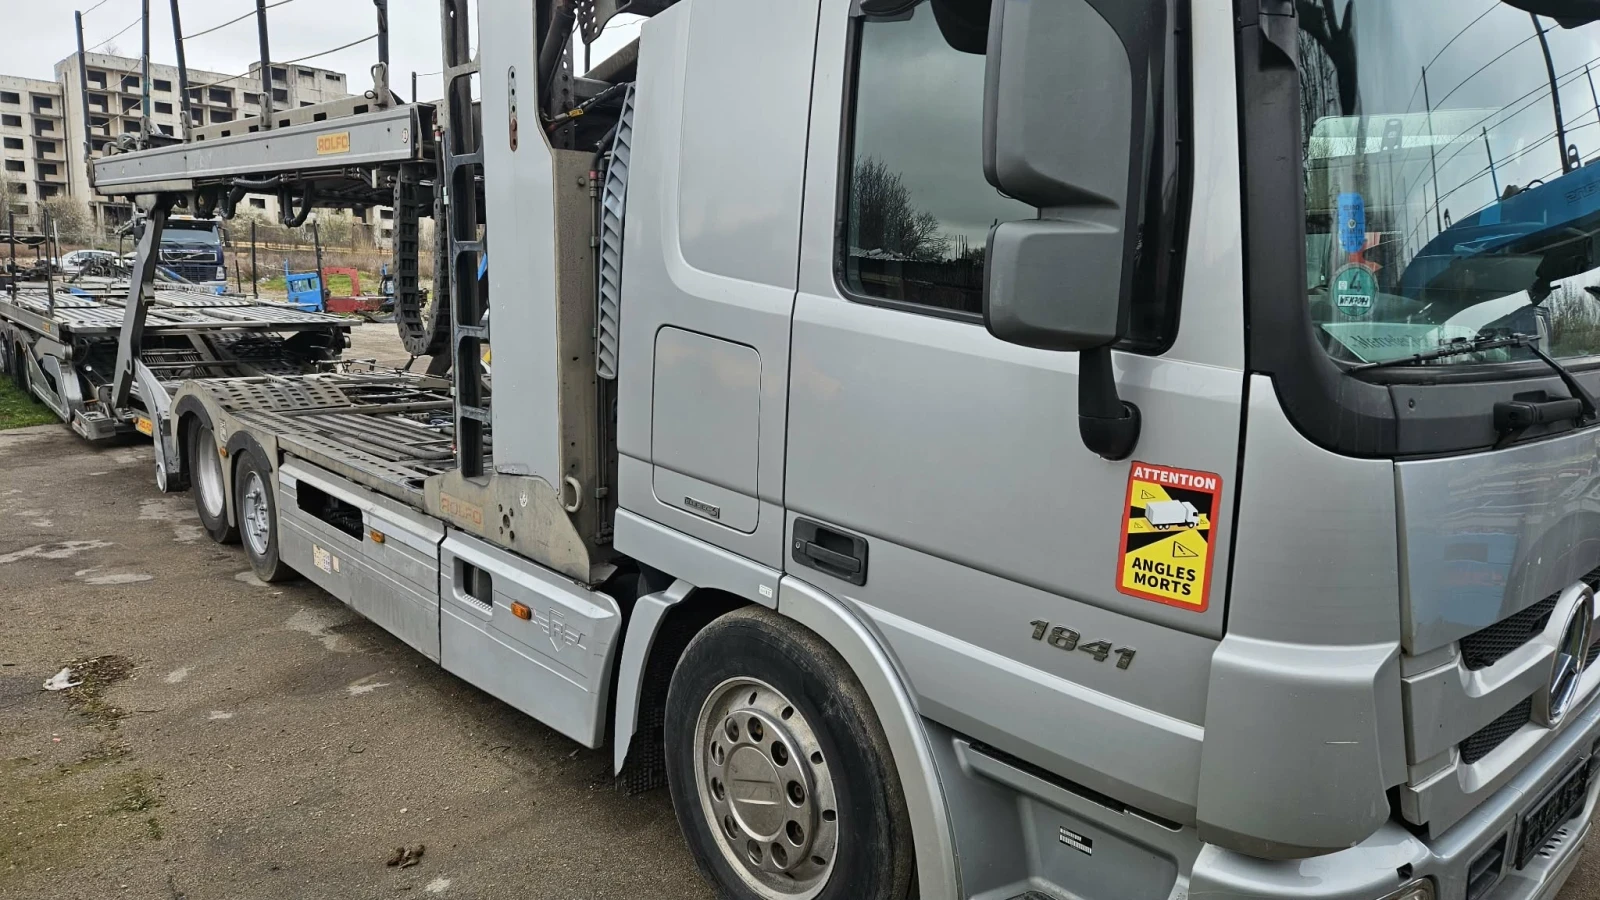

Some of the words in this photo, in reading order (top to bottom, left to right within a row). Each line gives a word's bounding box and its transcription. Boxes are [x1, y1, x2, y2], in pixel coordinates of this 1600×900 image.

[318, 136, 348, 151] ROLFO
[1349, 271, 1362, 293] 4
[1133, 466, 1216, 490] ATTENTION
[441, 498, 481, 524] ROLFO
[1131, 557, 1196, 582] ANGLES
[1133, 572, 1192, 596] MORTS
[1030, 620, 1136, 670] 1841
